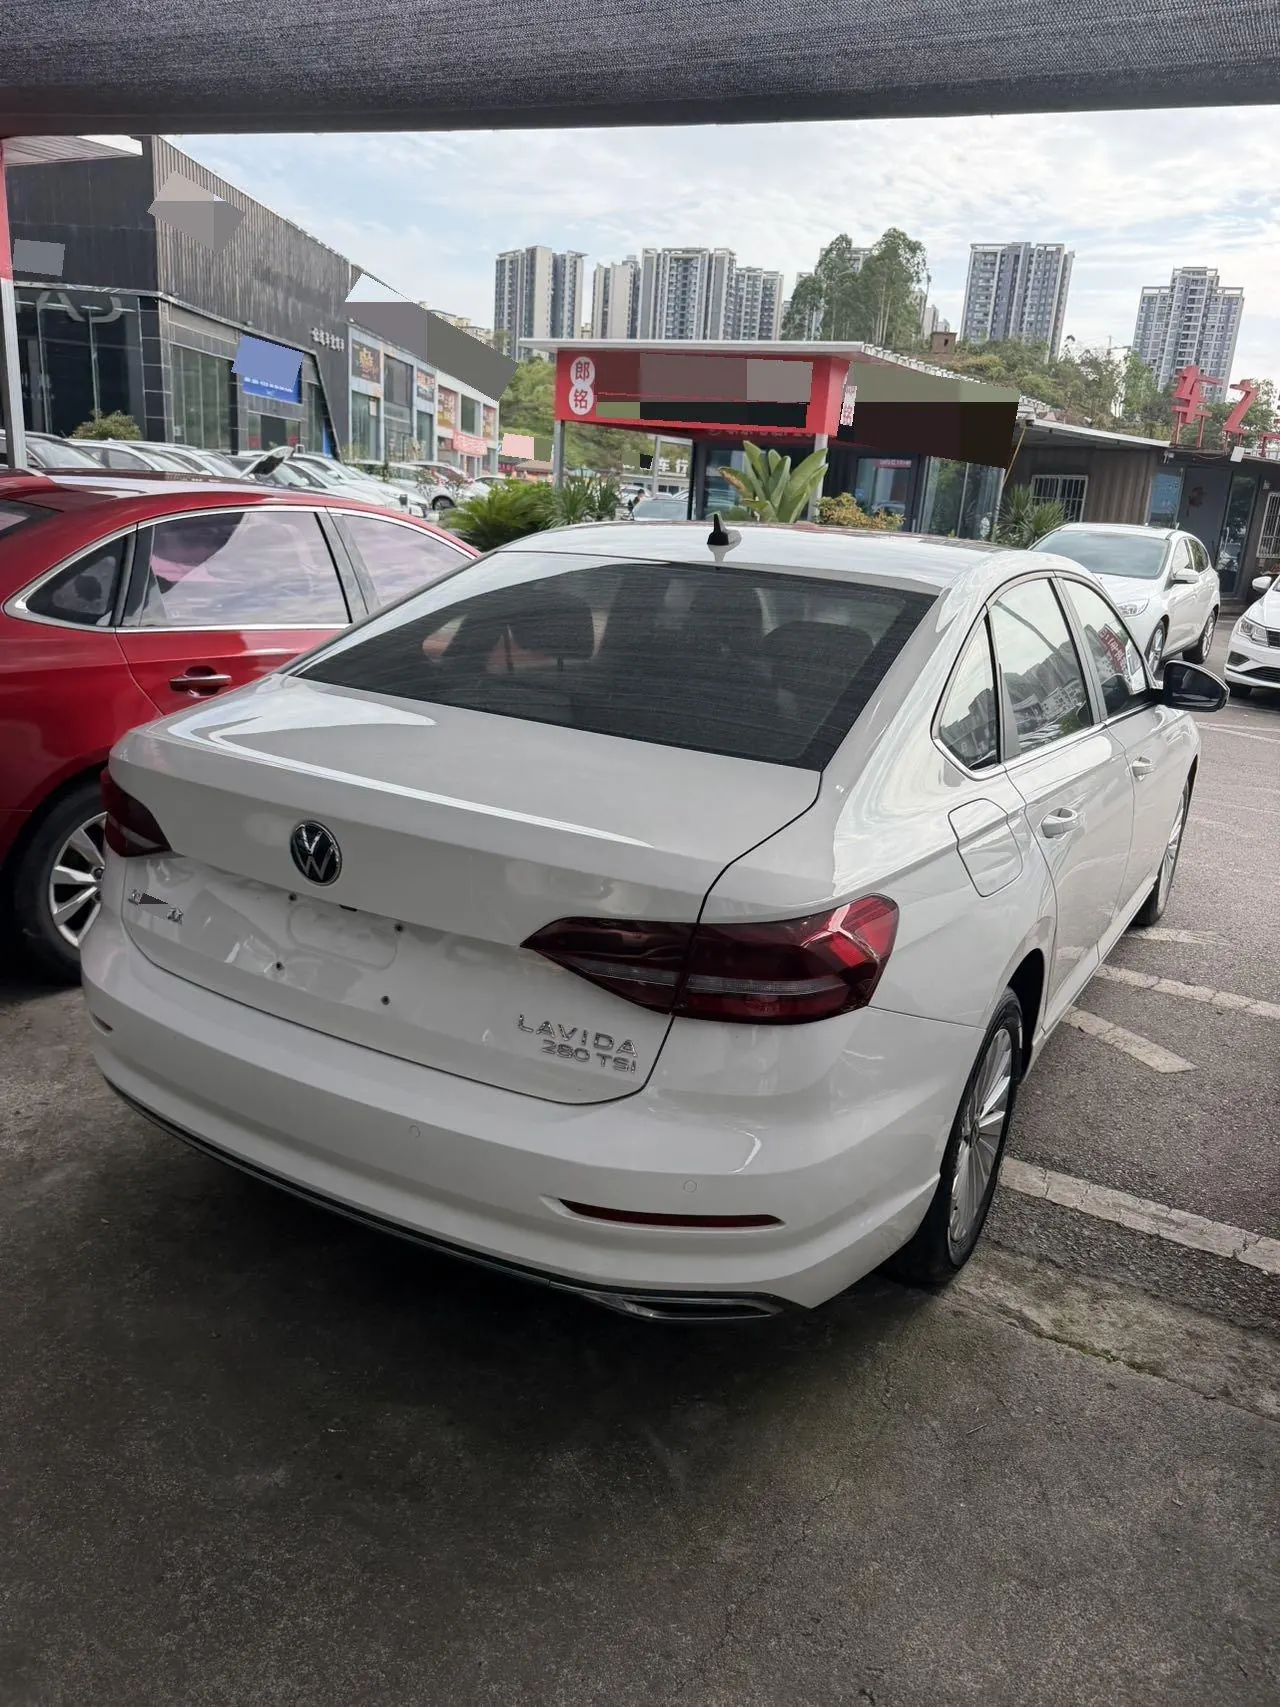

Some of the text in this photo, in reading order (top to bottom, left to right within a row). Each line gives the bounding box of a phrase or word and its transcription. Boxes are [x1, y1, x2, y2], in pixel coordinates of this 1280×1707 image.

[573, 359, 591, 409] 郎铭
[518, 1014, 637, 1057] LAVIDA
[541, 1039, 636, 1073] 280 TSI
